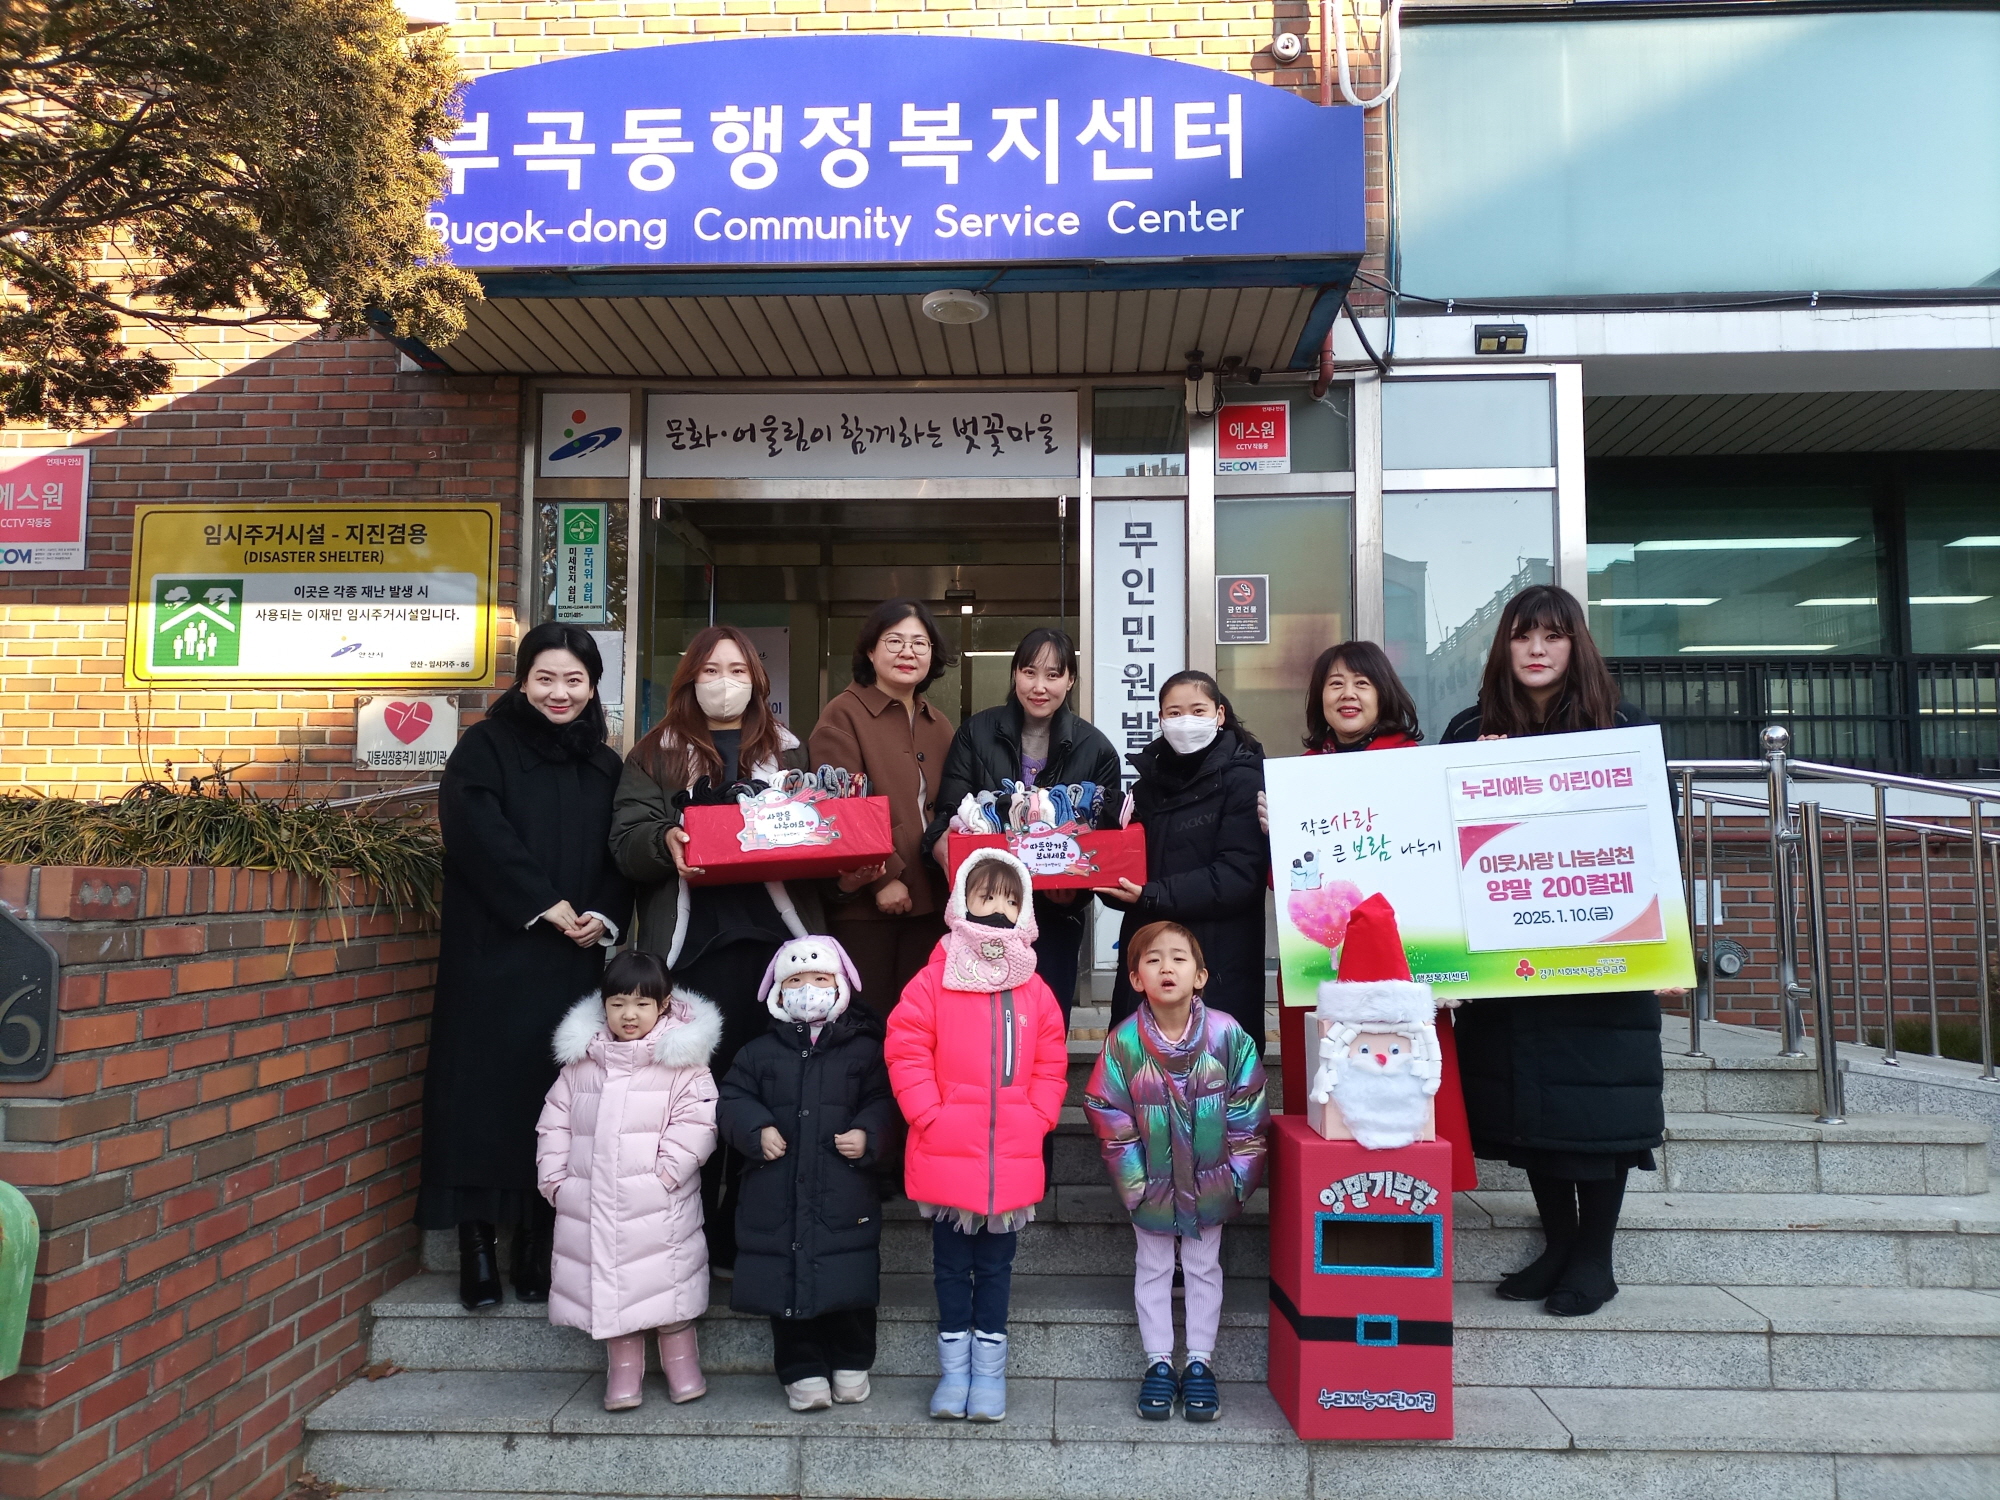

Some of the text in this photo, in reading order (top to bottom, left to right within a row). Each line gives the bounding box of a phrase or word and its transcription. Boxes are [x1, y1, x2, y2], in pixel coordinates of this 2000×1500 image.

[432, 94, 1243, 195] 부곡동행정복지센터
[425, 199, 1245, 252] Bugok-dong Community Service Center
[840, 412, 943, 455] 함께하는
[952, 412, 1059, 457] 벚꽃마을
[1228, 421, 1275, 440] 에스원
[1235, 442, 1269, 451] CCTV 작동중
[46, 457, 81, 467] 언제나 안심
[1218, 461, 1258, 472] SECOM
[0, 482, 64, 511] 에스원
[0, 517, 52, 528] CCTV 작동중
[203, 523, 326, 546] 임시주거시설
[345, 522, 428, 545] 지진겸용
[243, 549, 385, 566] (DISASTER SHELTER)
[567, 547, 577, 604] 미세먼지 쉼터
[583, 547, 594, 604] 무더위 쉼터
[294, 584, 429, 599] 이곳은 각종 재난 발생 시
[255, 608, 461, 622] 사용되는 이재민 임시주거시설입니다.
[358, 651, 384, 659] 안산시
[410, 660, 424, 669] 안산
[1119, 522, 1159, 796] 무인민원발
[366, 750, 447, 766] 자동심장충격기 설치기관
[1461, 766, 1634, 800] 누리예능 어린이집
[767, 810, 791, 822] 사랑을
[1036, 851, 1067, 860] 보내세요
[1332, 833, 1442, 863] 큰 보람 나누기
[1479, 846, 1635, 874] 이웃사랑 나눔실천
[1486, 871, 1635, 902] 양말 200켤레
[1416, 971, 1469, 984] 행정복지센터
[1538, 964, 1627, 980] 경기 사회복지공동모금회
[1319, 1170, 1440, 1216] 양말기부함
[1318, 1388, 1437, 1414] 누리예능어린이집
